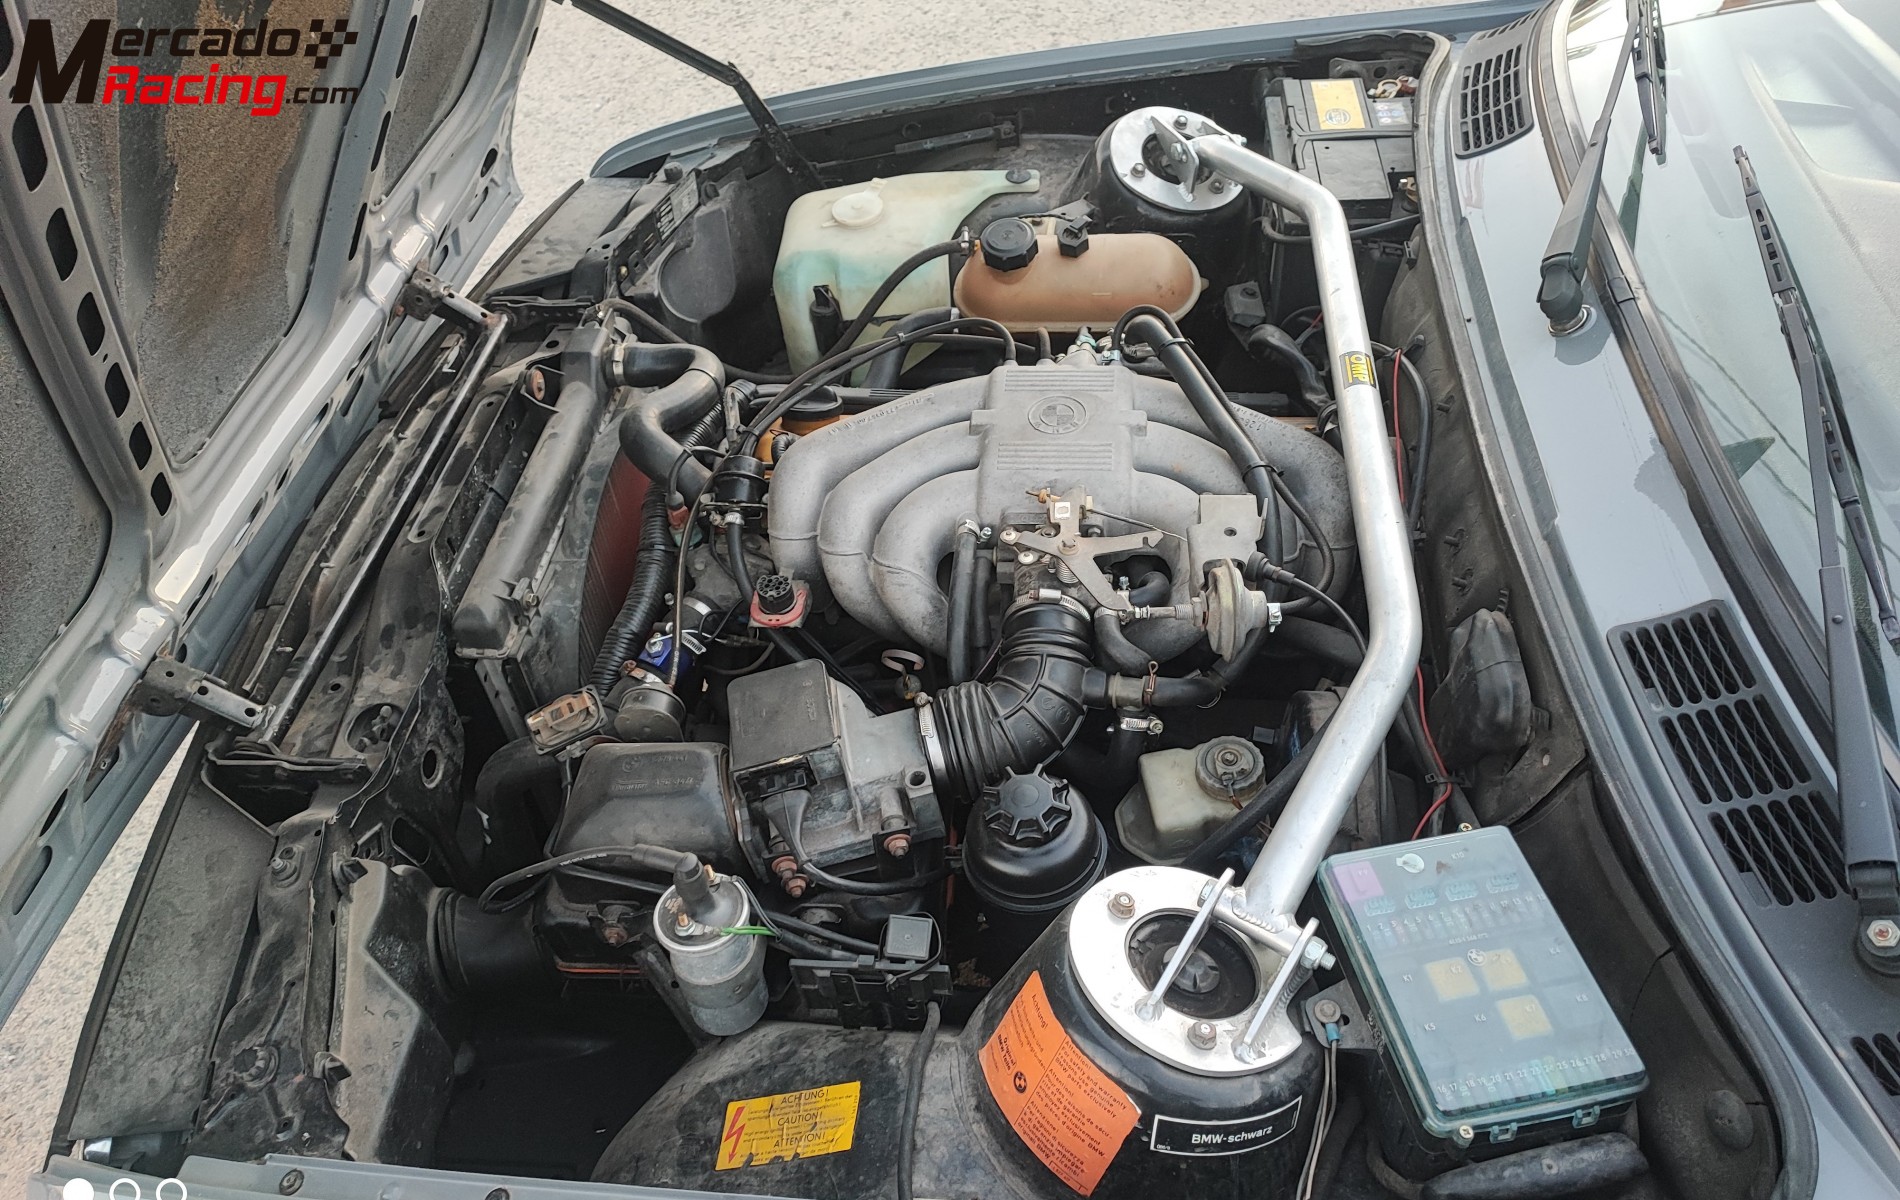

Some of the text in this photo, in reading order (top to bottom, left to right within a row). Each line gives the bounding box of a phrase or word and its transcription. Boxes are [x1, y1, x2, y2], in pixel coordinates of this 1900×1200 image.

[1350, 354, 1370, 382] OMP
[1451, 851, 1465, 860] K10
[1403, 973, 1413, 982] K1
[1424, 1022, 1436, 1031] K5
[1474, 1013, 1487, 1022] K6
[780, 1088, 829, 1105] ACHTUNG!
[1066, 1073, 1083, 1090] parts
[1082, 1089, 1117, 1119] exclusively
[1089, 1086, 1114, 1108] genuine
[1098, 1085, 1128, 1111] warranty
[777, 1111, 823, 1127] CAUTION!
[1060, 1111, 1102, 1147] exclusivement
[1191, 1125, 1273, 1144] BMW-schwarz
[773, 1131, 826, 1149] ATTENTION!
